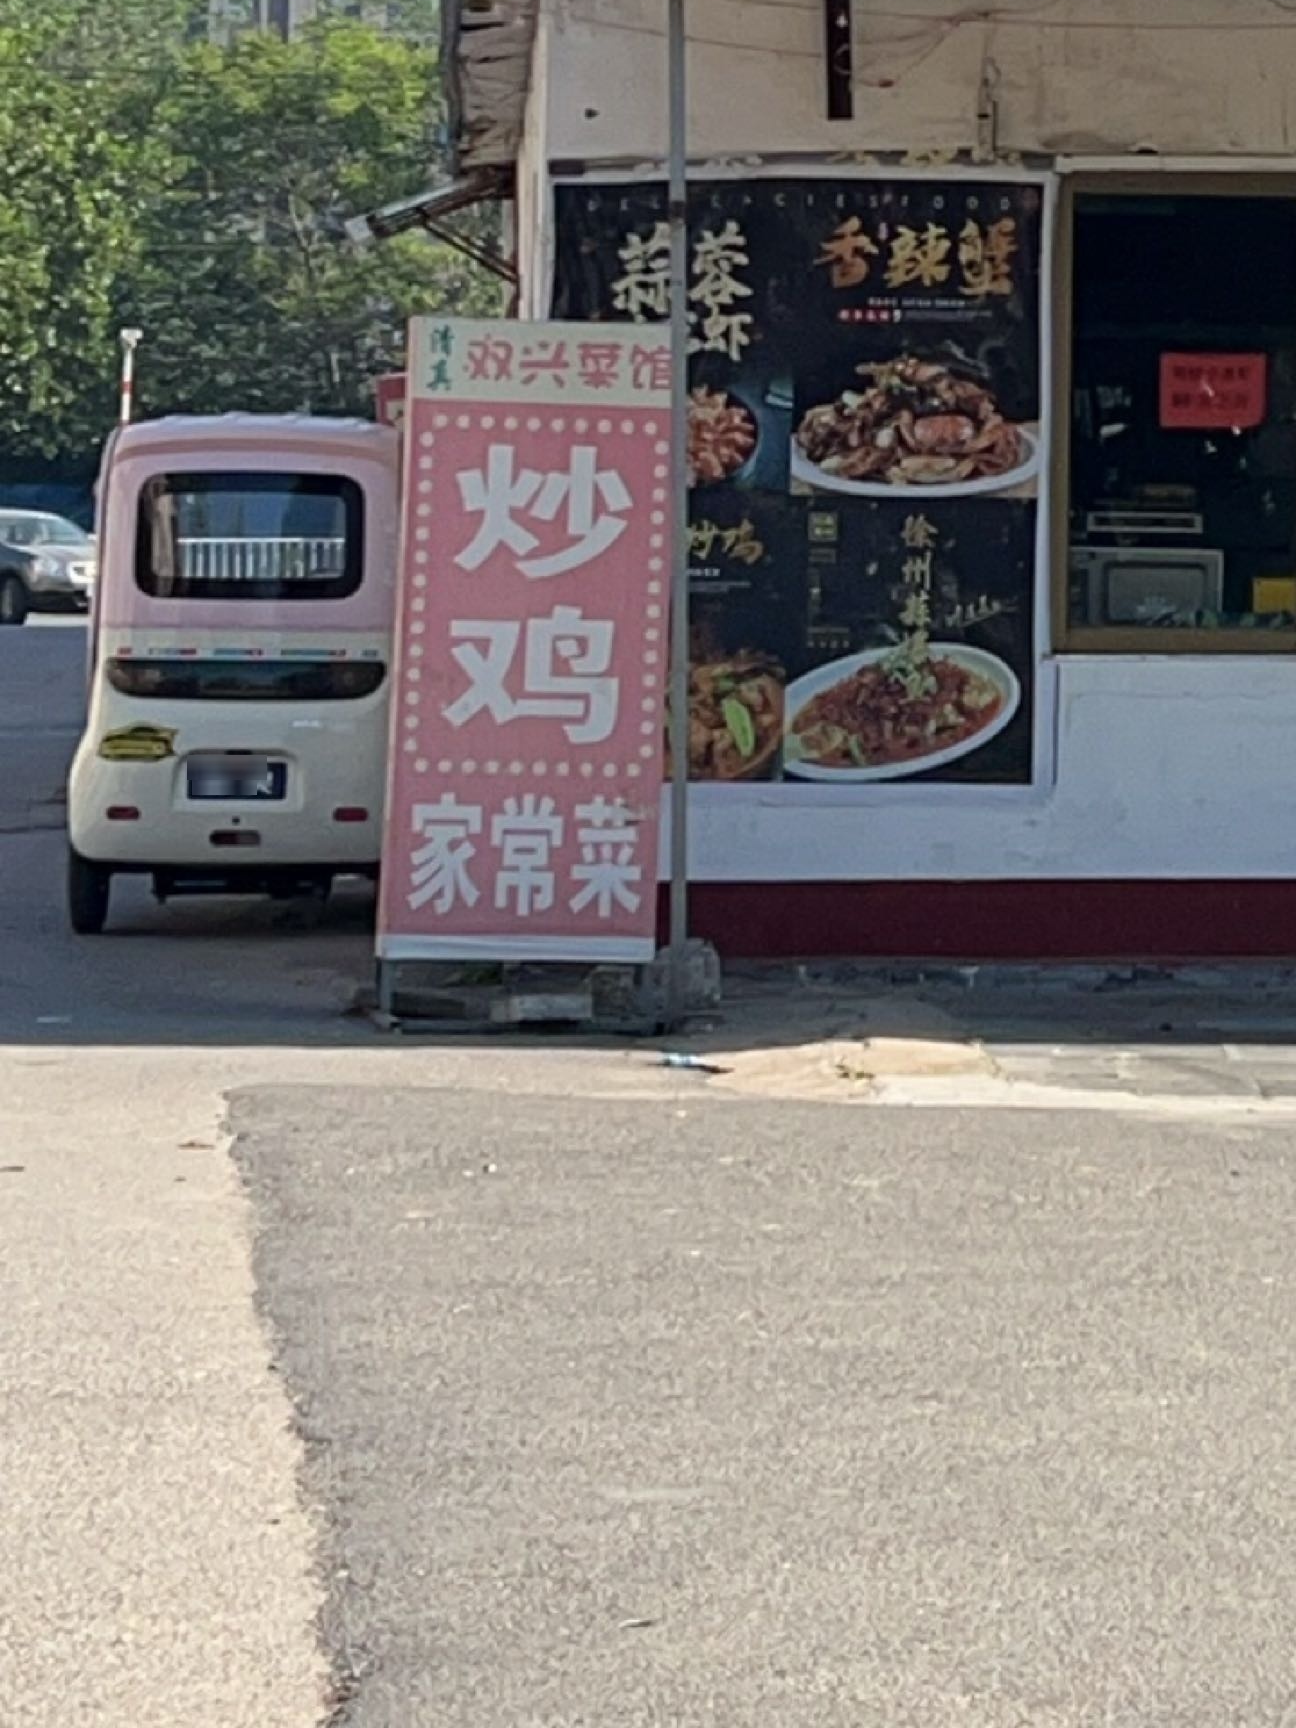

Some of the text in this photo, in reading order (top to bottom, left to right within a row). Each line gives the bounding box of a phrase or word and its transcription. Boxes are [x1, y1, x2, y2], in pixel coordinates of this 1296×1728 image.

[425, 324, 456, 391] 清真
[463, 332, 672, 391] 双兴菜馆
[441, 442, 633, 745] 炒鸡
[406, 792, 642, 917] 家常菜
